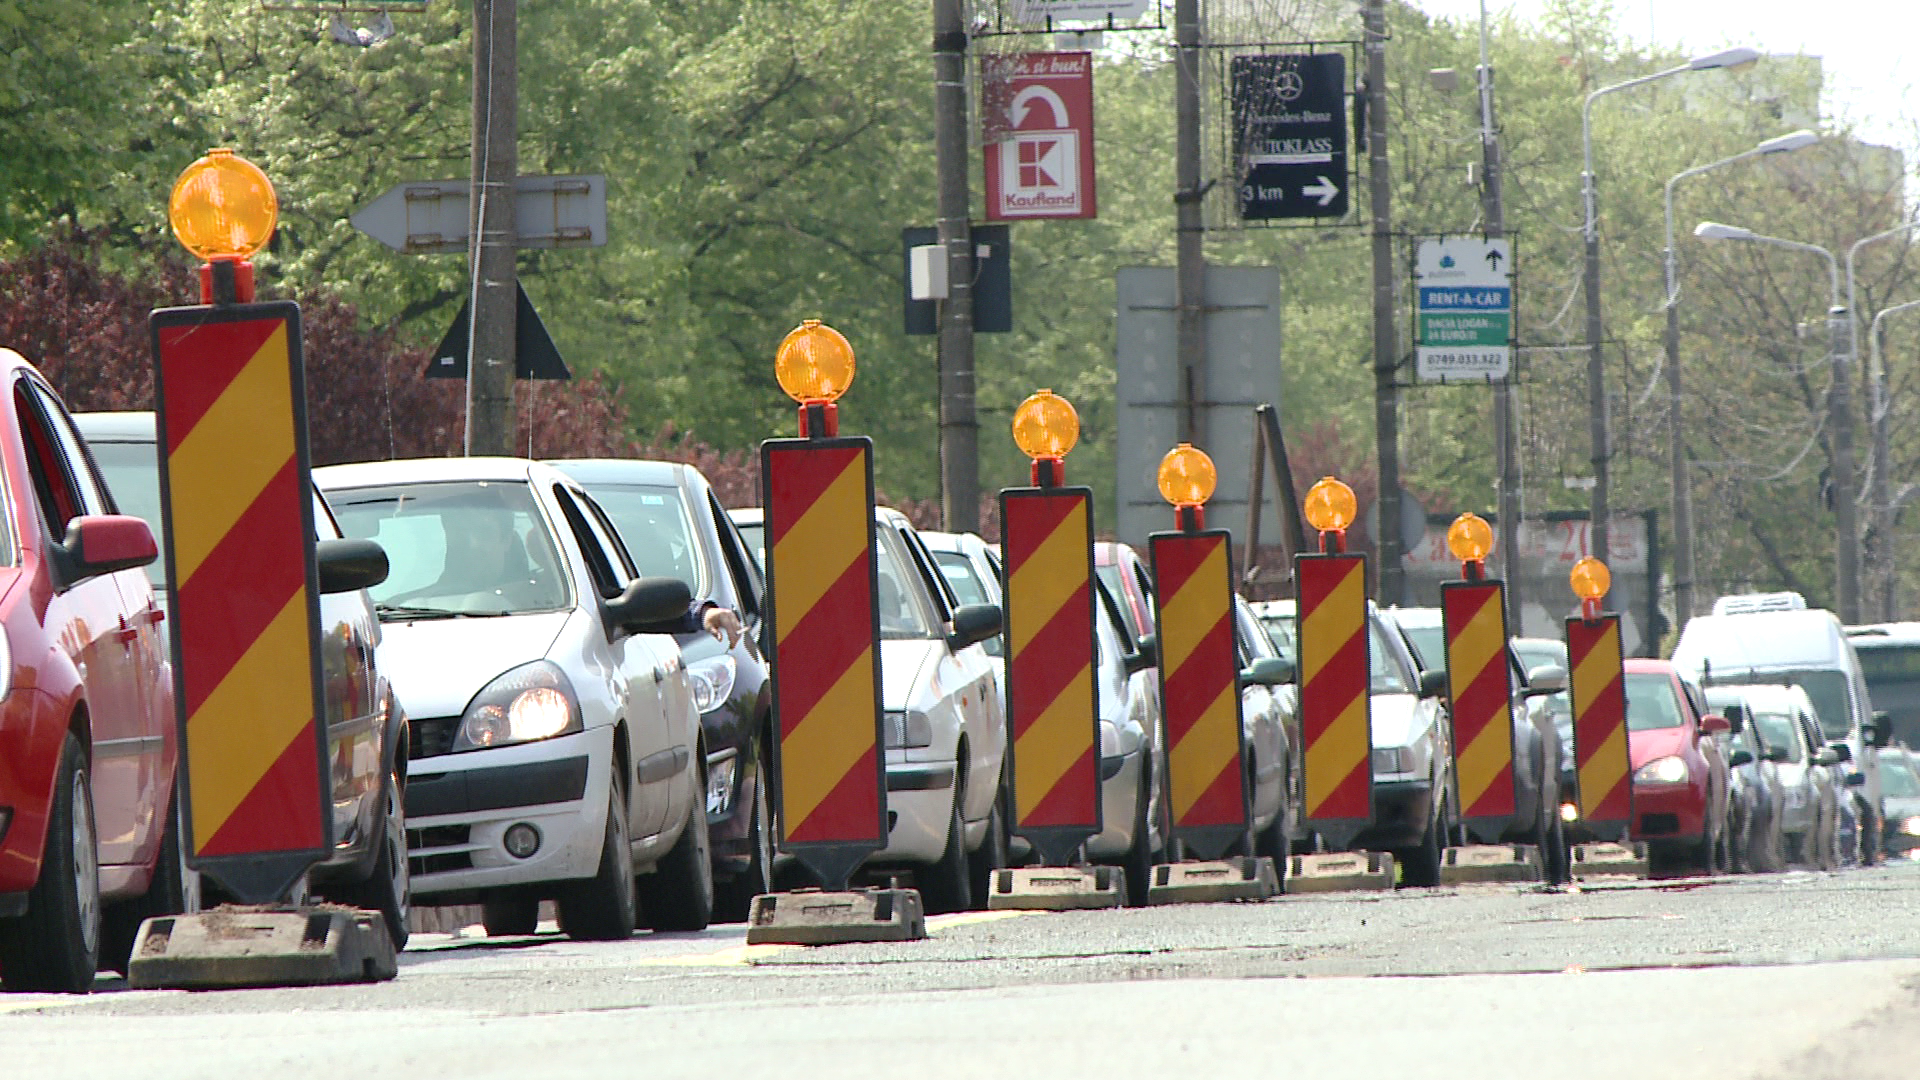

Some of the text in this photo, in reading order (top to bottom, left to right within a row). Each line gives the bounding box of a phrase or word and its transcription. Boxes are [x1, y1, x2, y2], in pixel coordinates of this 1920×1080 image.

[1050, 56, 1087, 73] bun!
[1006, 192, 1075, 206] Kaufland
[1242, 184, 1284, 201] 3 km
[1428, 292, 1502, 305] RENT-A-CAR
[1457, 318, 1488, 329] LOGAN
